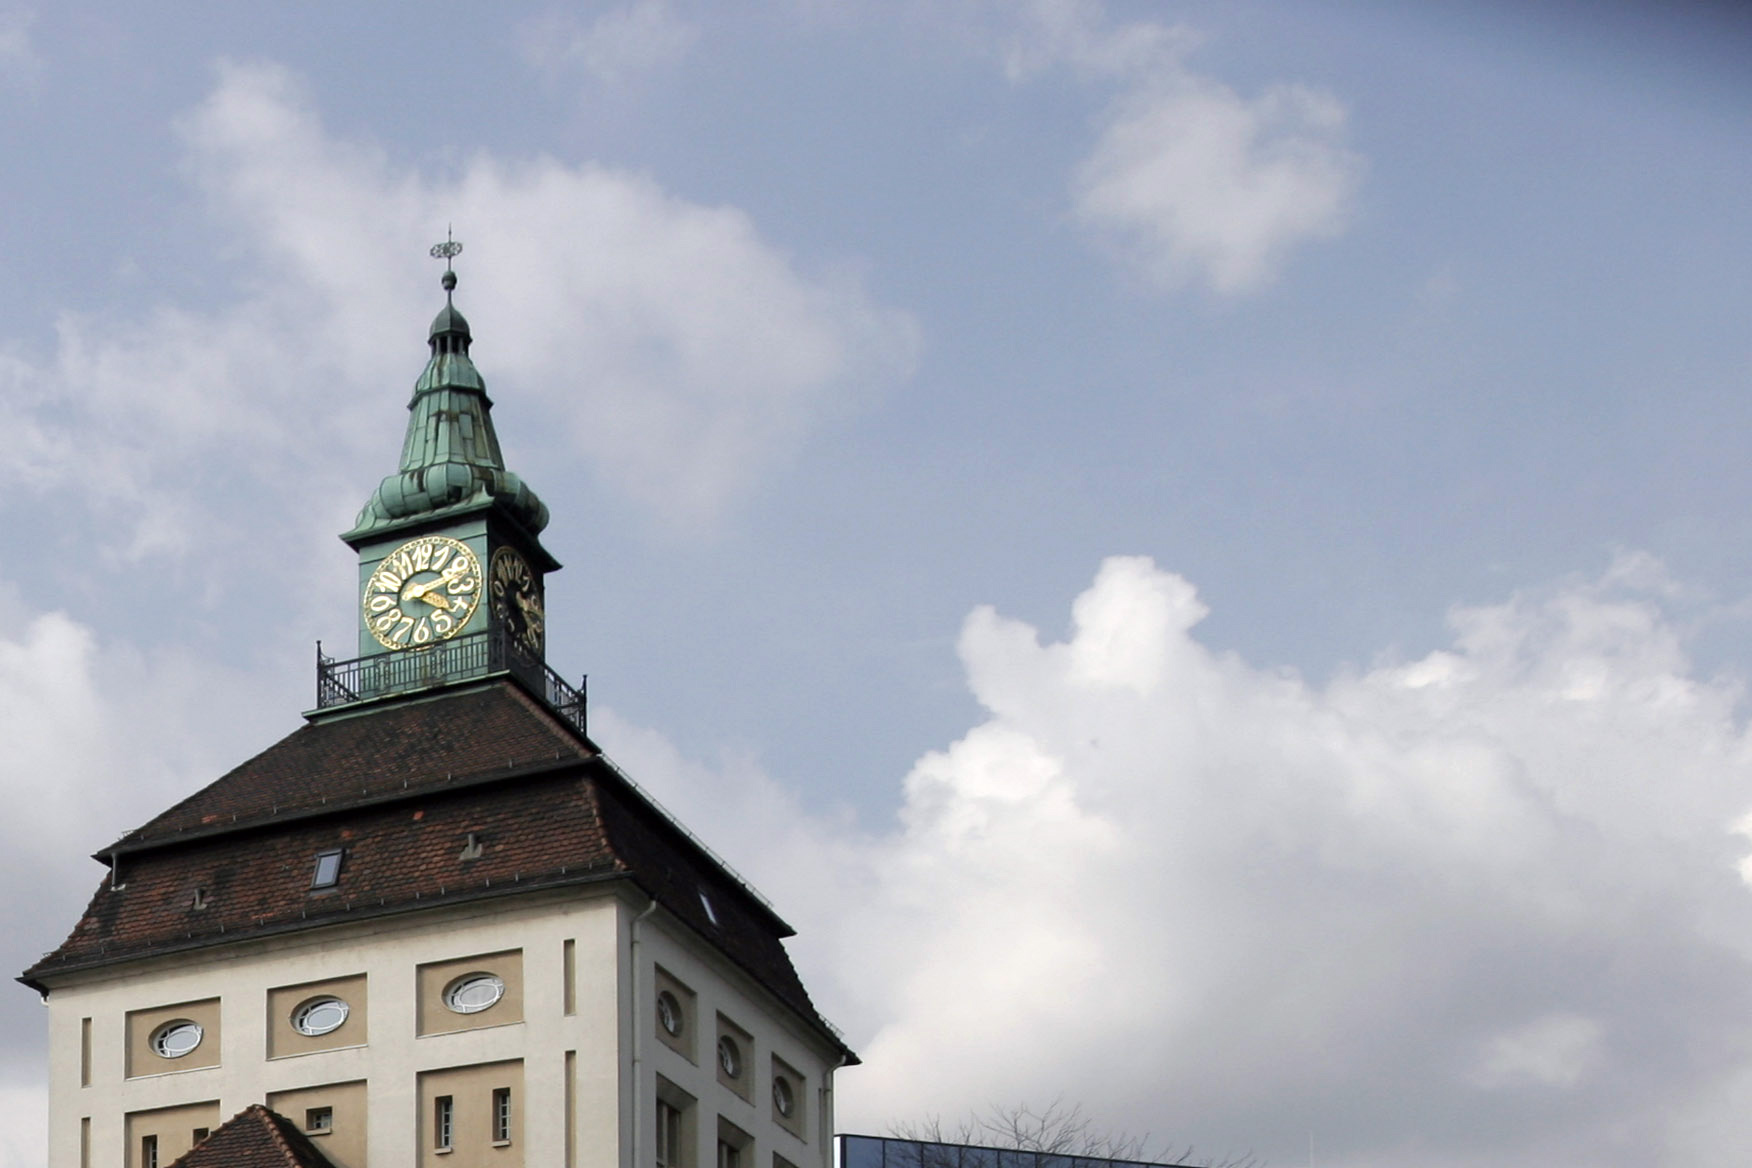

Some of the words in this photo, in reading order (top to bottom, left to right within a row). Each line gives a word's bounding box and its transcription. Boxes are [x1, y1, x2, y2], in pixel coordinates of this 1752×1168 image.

[374, 571, 402, 593] 10
[447, 578, 475, 595] 3
[370, 595, 397, 612] 9
[376, 608, 402, 631] 8
[392, 616, 415, 642] 7
[413, 616, 429, 643] 6
[430, 608, 452, 633] 5
